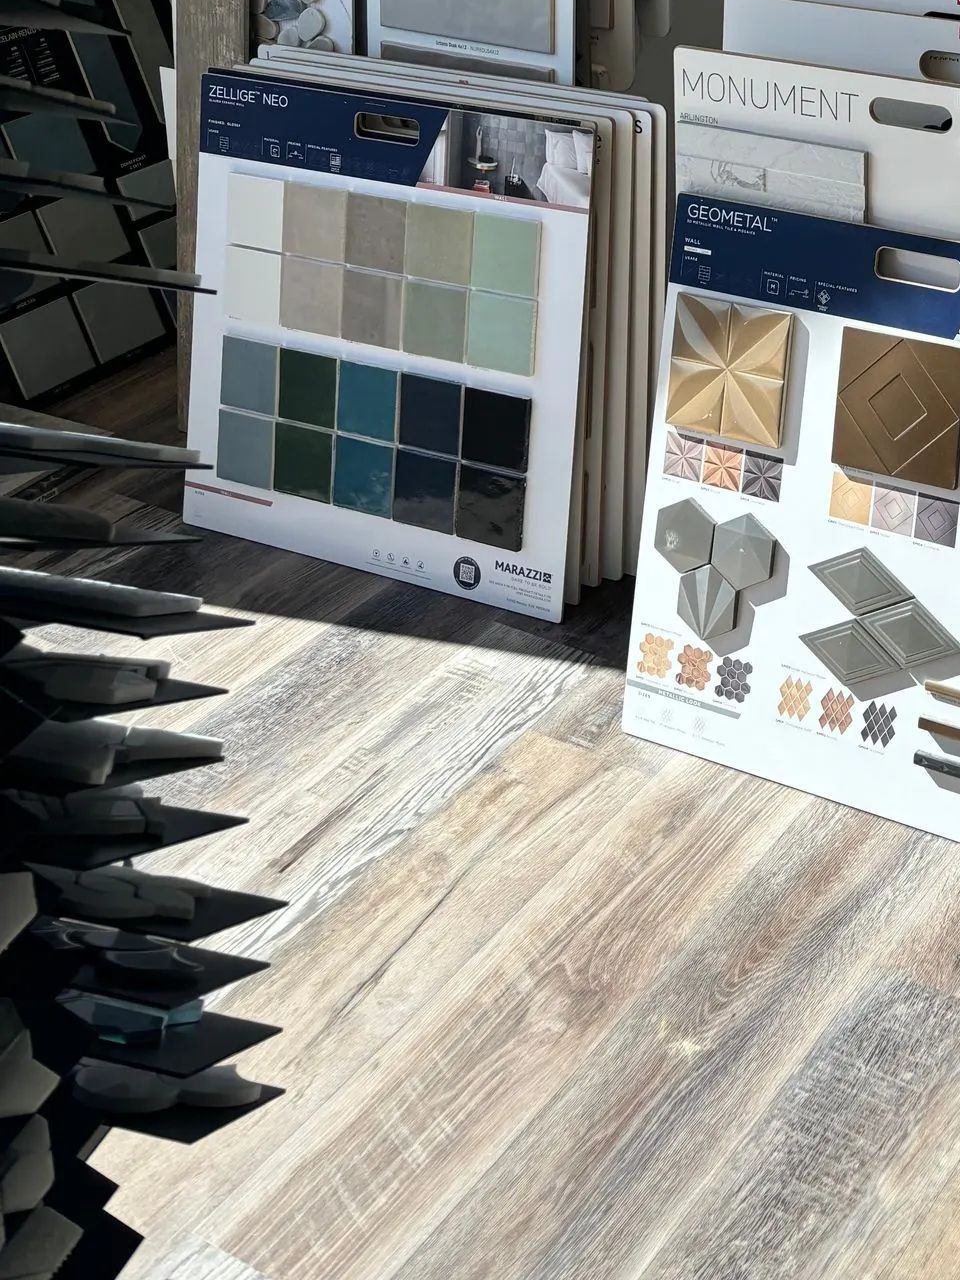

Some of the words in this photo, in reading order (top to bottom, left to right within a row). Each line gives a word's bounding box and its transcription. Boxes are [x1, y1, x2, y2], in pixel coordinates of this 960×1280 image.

[262, 93, 289, 109] NEO
[682, 67, 861, 124] MONUMENT
[679, 111, 720, 126] ARLINGTON
[684, 237, 701, 245] WALL
[763, 270, 785, 280] MATERIAL
[494, 559, 543, 583] MARAZZI
